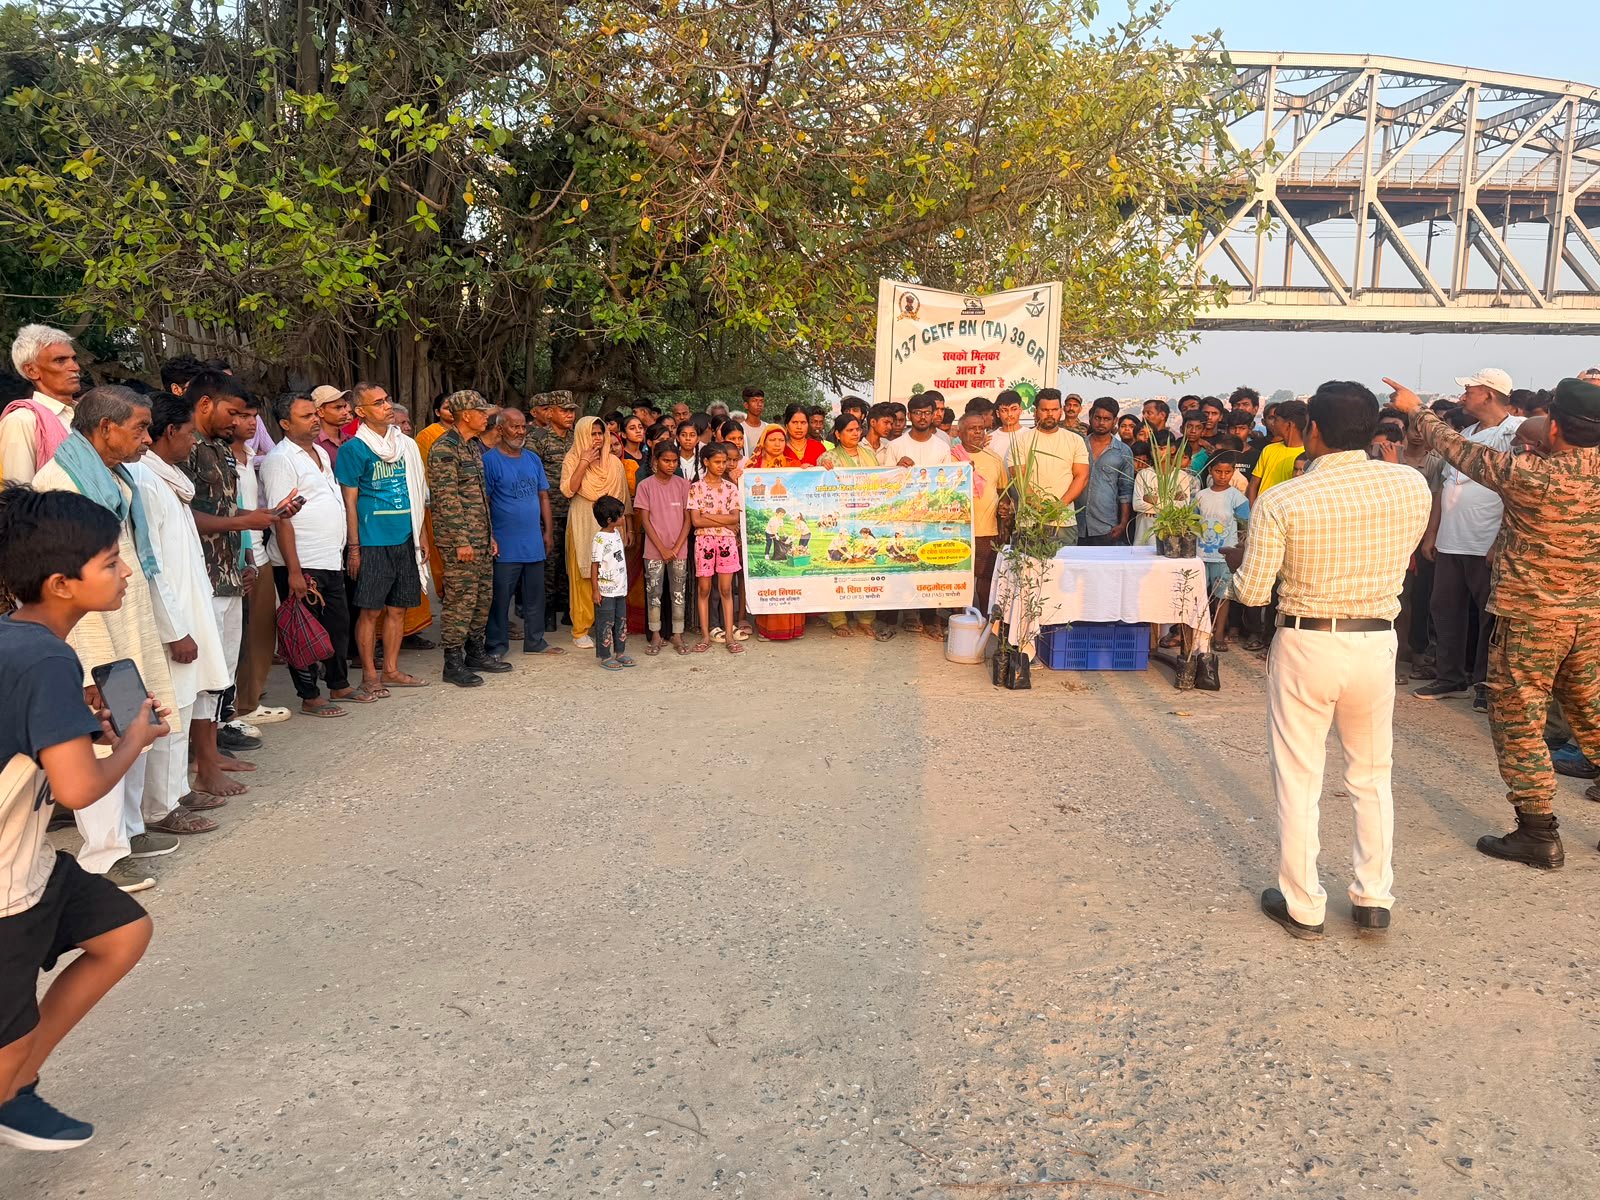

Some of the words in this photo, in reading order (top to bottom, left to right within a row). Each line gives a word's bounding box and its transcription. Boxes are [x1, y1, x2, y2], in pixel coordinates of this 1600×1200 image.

[895, 334, 916, 364] 137
[922, 321, 955, 345] CETF
[959, 319, 977, 336] BN
[981, 319, 1007, 344] (TA)
[1010, 327, 1026, 347] 39
[1026, 339, 1045, 366] GR
[942, 349, 968, 361] सबको
[971, 349, 1000, 361] मिलकर
[956, 365, 977, 375] आना
[979, 363, 986, 375] है
[934, 377, 968, 389] पर्यावरण
[997, 376, 1005, 389] है
